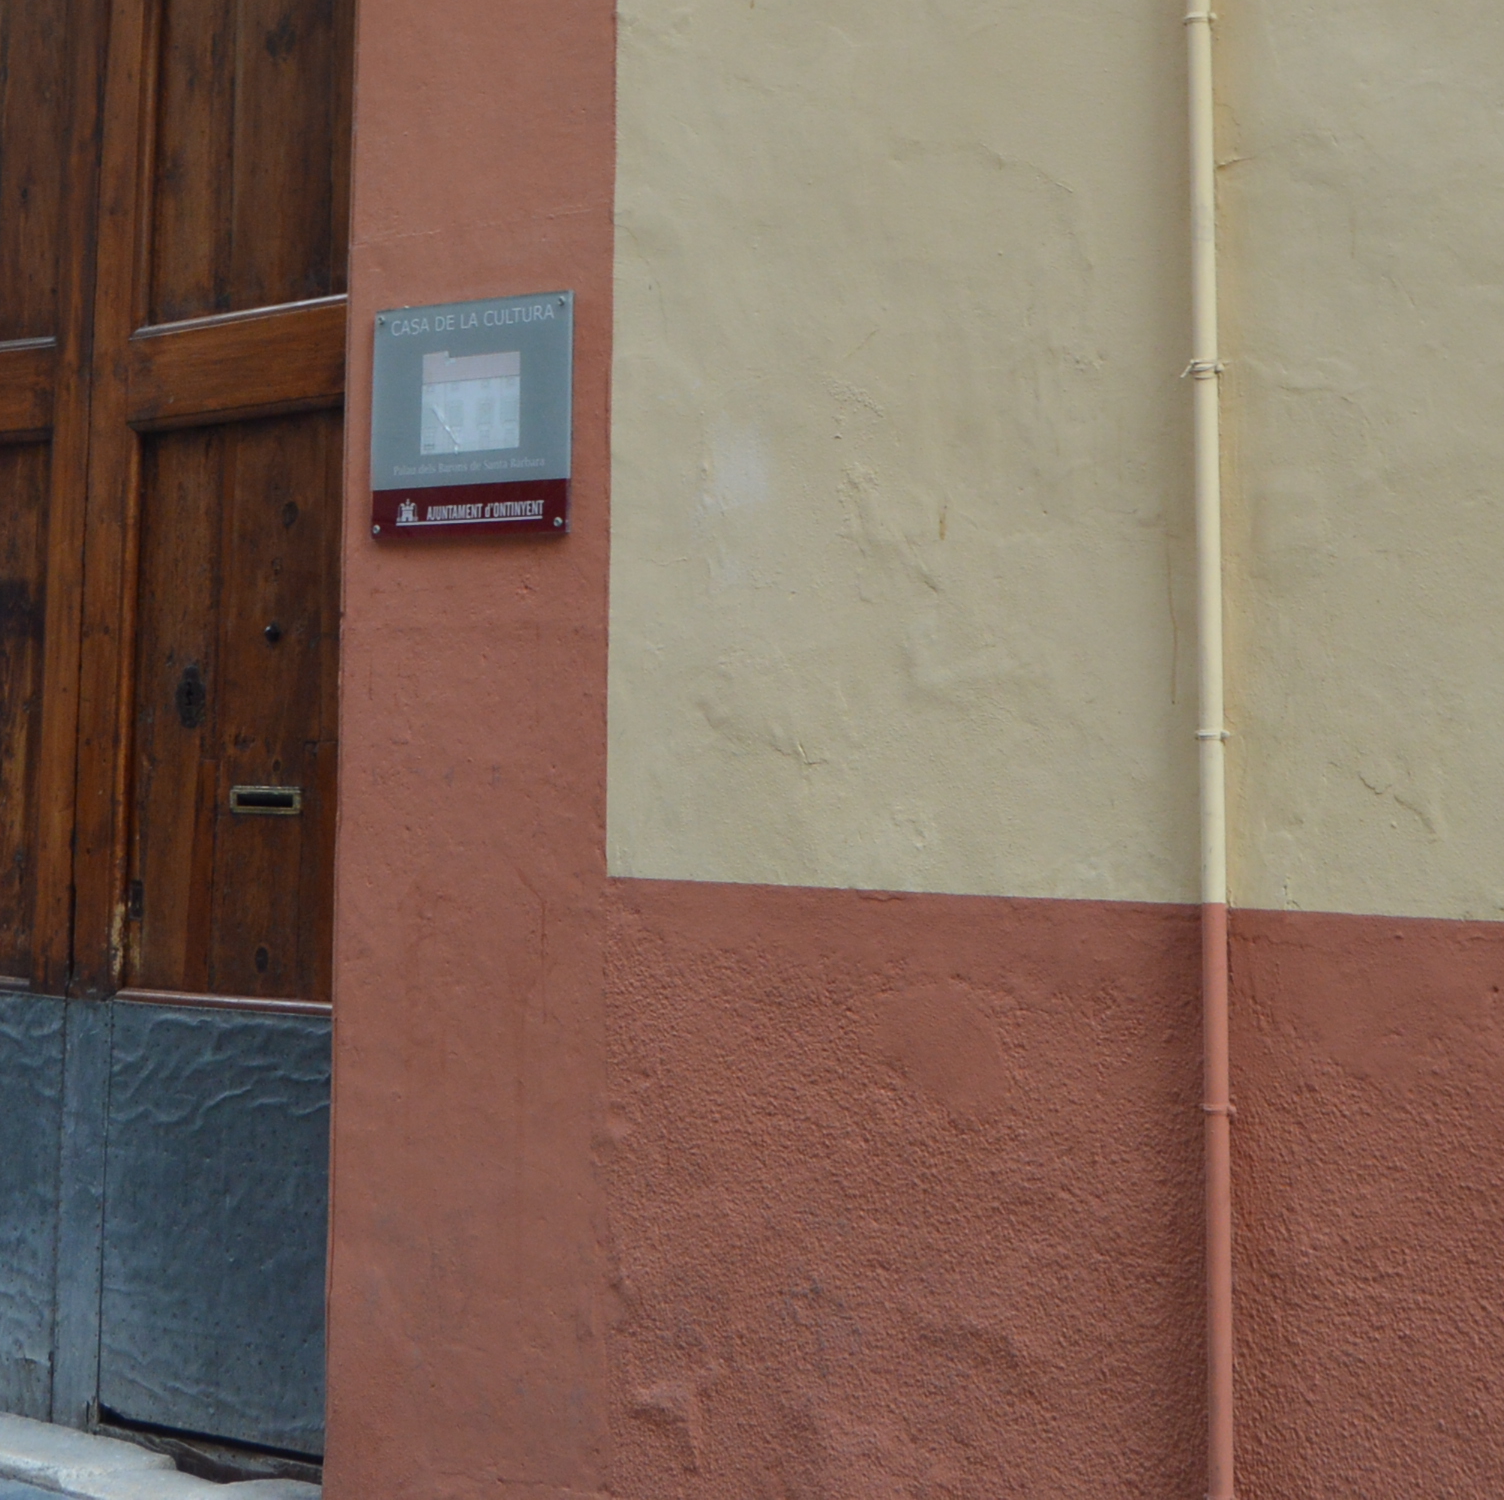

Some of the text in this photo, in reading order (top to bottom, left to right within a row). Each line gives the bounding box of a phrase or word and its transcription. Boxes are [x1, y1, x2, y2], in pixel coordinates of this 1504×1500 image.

[391, 304, 554, 337] CASA DE LA CULTURA
[426, 500, 544, 521] AJUNTAMENT d'ONTINYENT
